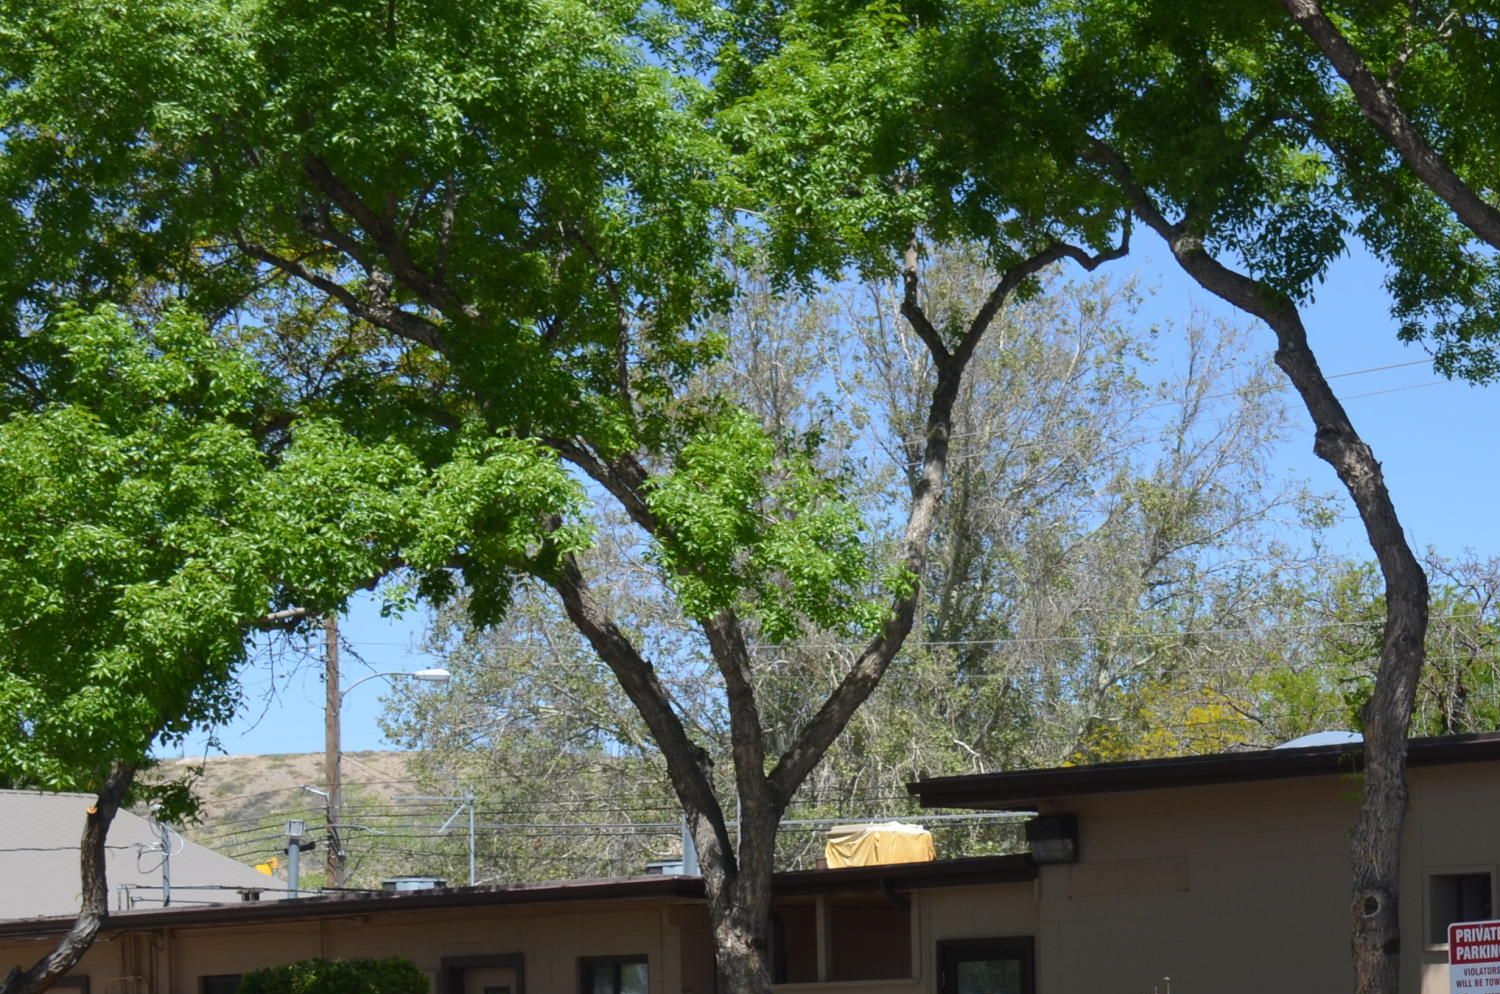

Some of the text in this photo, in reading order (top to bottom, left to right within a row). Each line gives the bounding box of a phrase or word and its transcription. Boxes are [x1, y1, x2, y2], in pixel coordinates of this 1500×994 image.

[1464, 966, 1500, 976] VIOLATORS
[1456, 980, 1472, 988] WILL
[1474, 979, 1483, 987] BE
